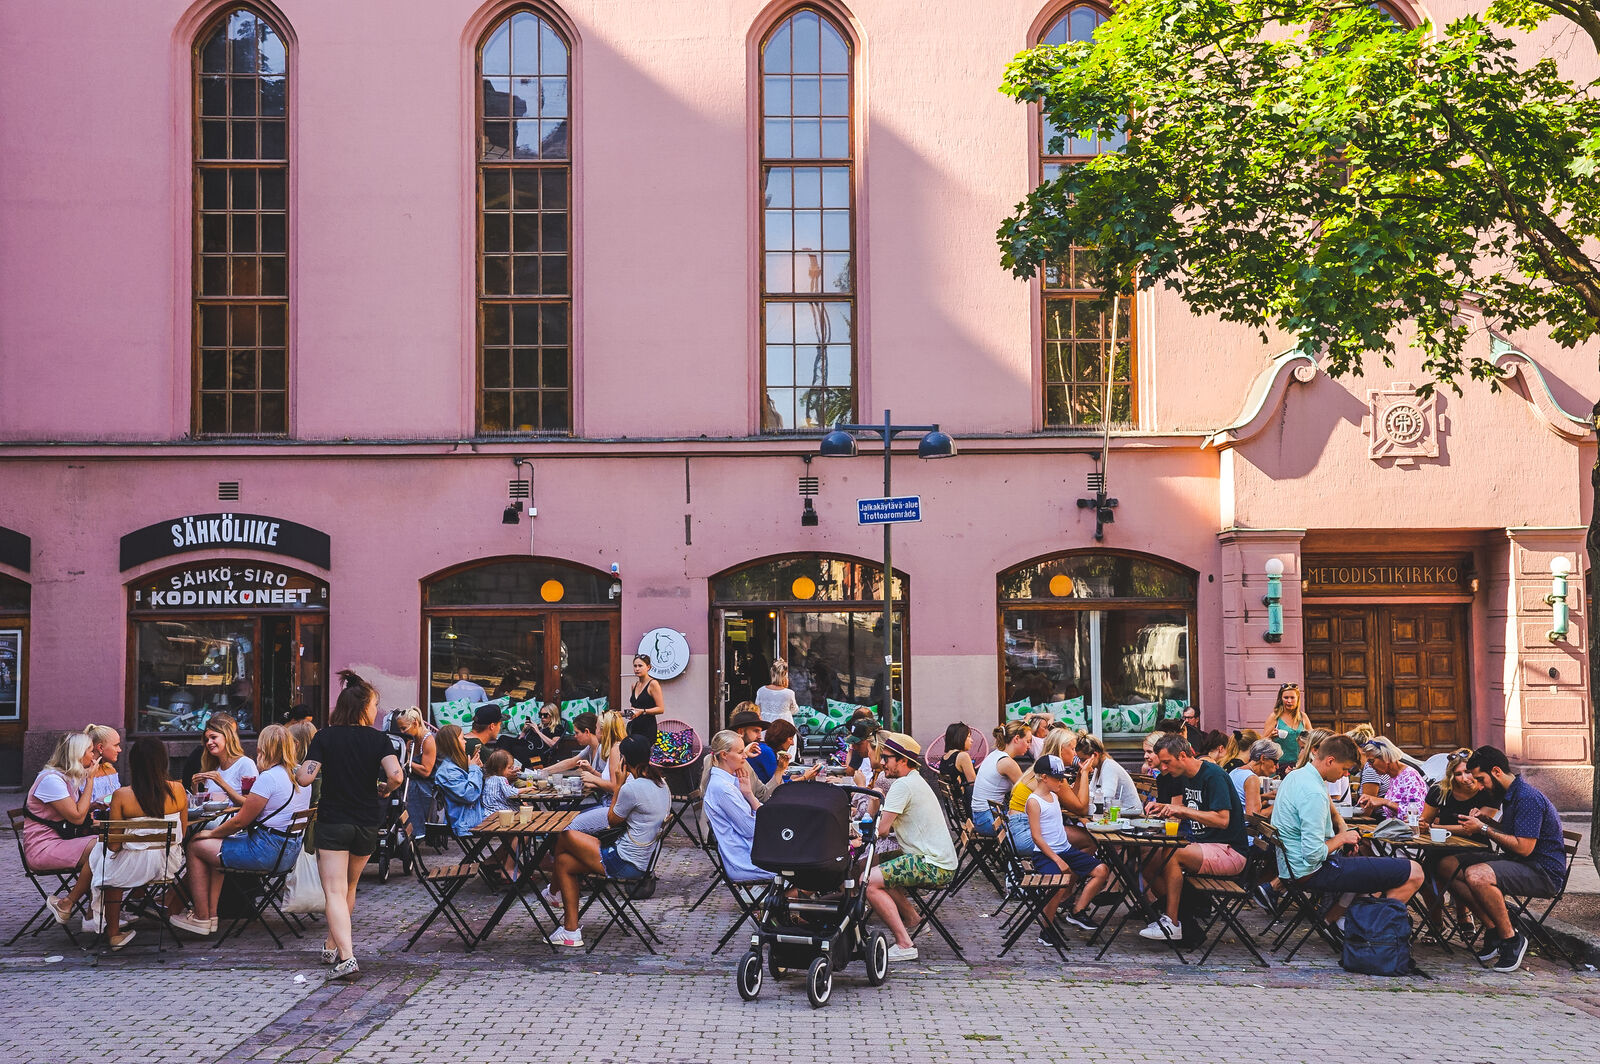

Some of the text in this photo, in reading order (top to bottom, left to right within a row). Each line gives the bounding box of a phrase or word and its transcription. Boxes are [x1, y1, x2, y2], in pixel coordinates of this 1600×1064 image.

[863, 510, 916, 520] Trottoarområde
[171, 513, 280, 548] SÄHKÖLIIKE
[1308, 567, 1458, 584] METODISTIKIRKKO
[151, 588, 312, 605] KODINKONEET
